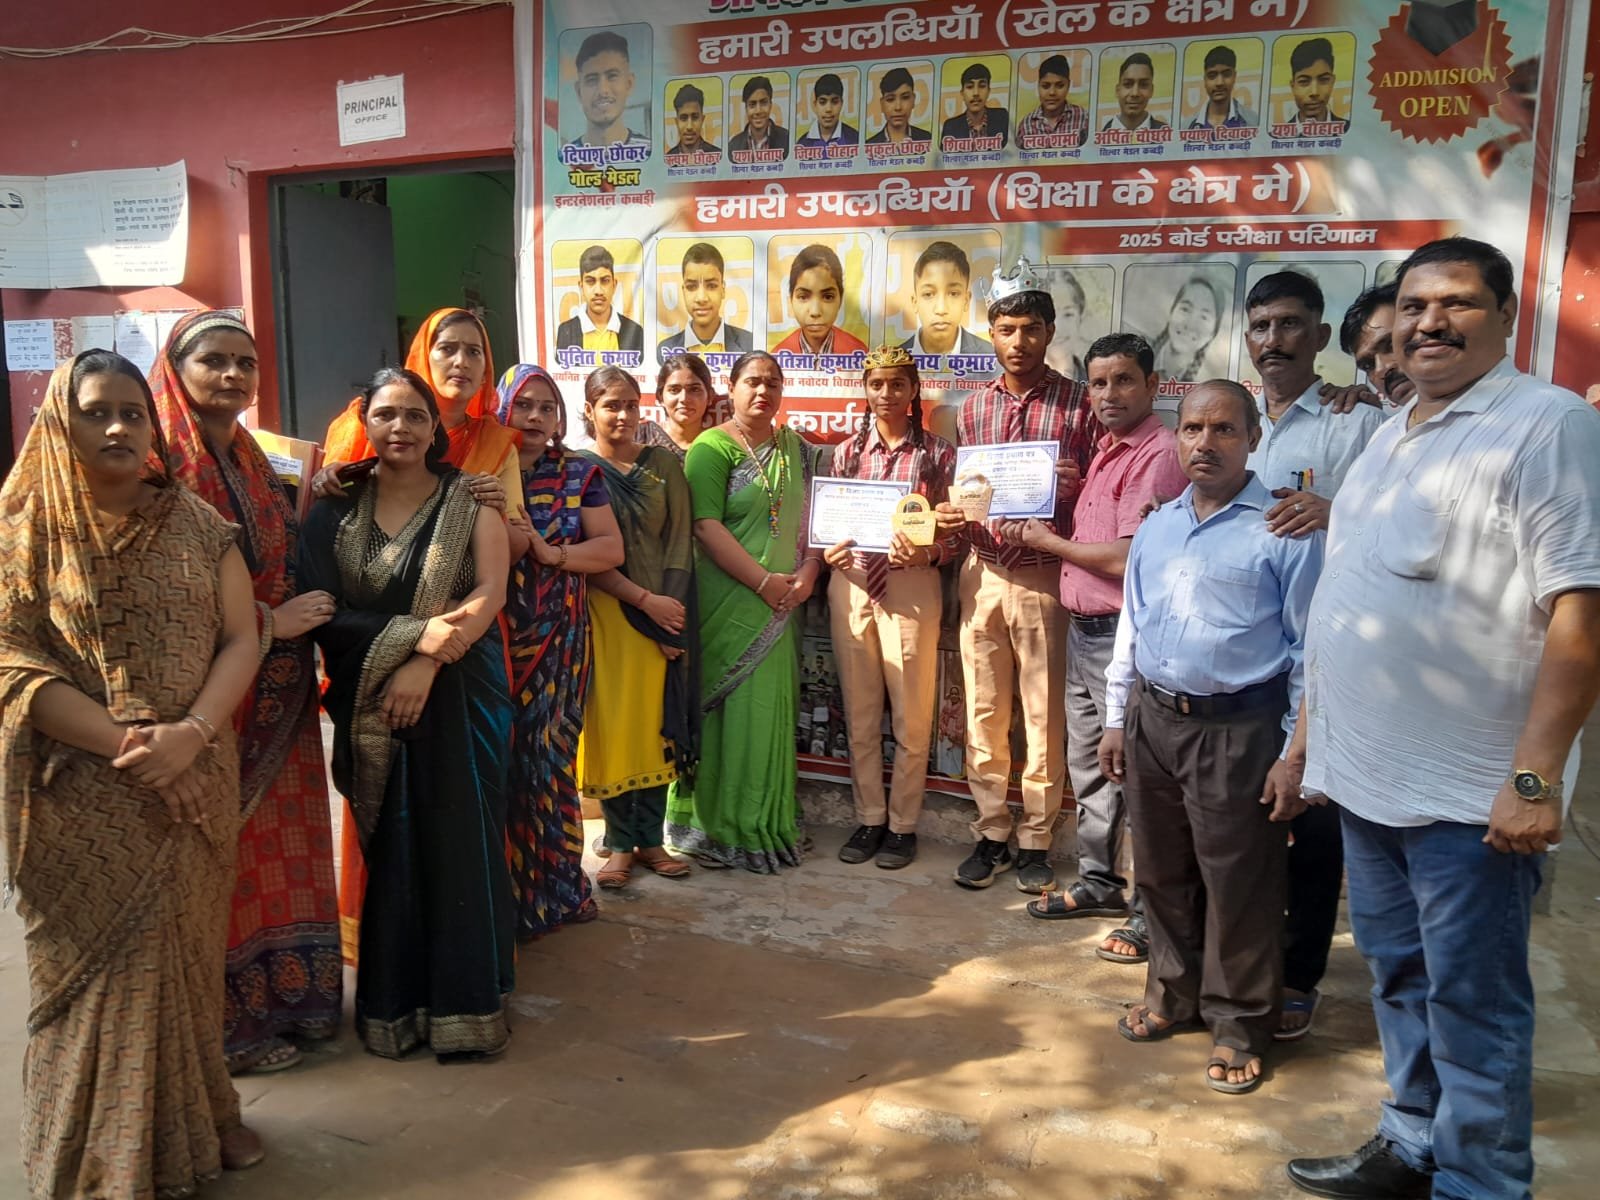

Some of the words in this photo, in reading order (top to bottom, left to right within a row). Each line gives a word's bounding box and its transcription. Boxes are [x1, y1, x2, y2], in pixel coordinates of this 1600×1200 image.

[697, 20, 792, 64] हमारी
[1380, 66, 1498, 88] ADDMISION
[344, 95, 398, 115] PRINCIPAL
[1400, 95, 1472, 118] OPEN
[355, 113, 388, 124] OFFICE
[975, 132, 1003, 151] शर्मा
[1050, 130, 1079, 147] शर्मा
[568, 168, 603, 188] गोल्ड
[605, 166, 641, 186] मेडल
[695, 183, 788, 223] हमारी
[1112, 168, 1158, 206] के
[1168, 165, 1240, 204] क्षेत्र
[1119, 233, 1162, 248] 2025
[1169, 226, 1211, 247] बोर्ड
[1216, 224, 1282, 246] परीक्षा
[1288, 223, 1378, 244] परिणाम
[558, 346, 596, 369] पुनित
[704, 352, 740, 373] कुमा
[947, 354, 997, 376] कुमार
